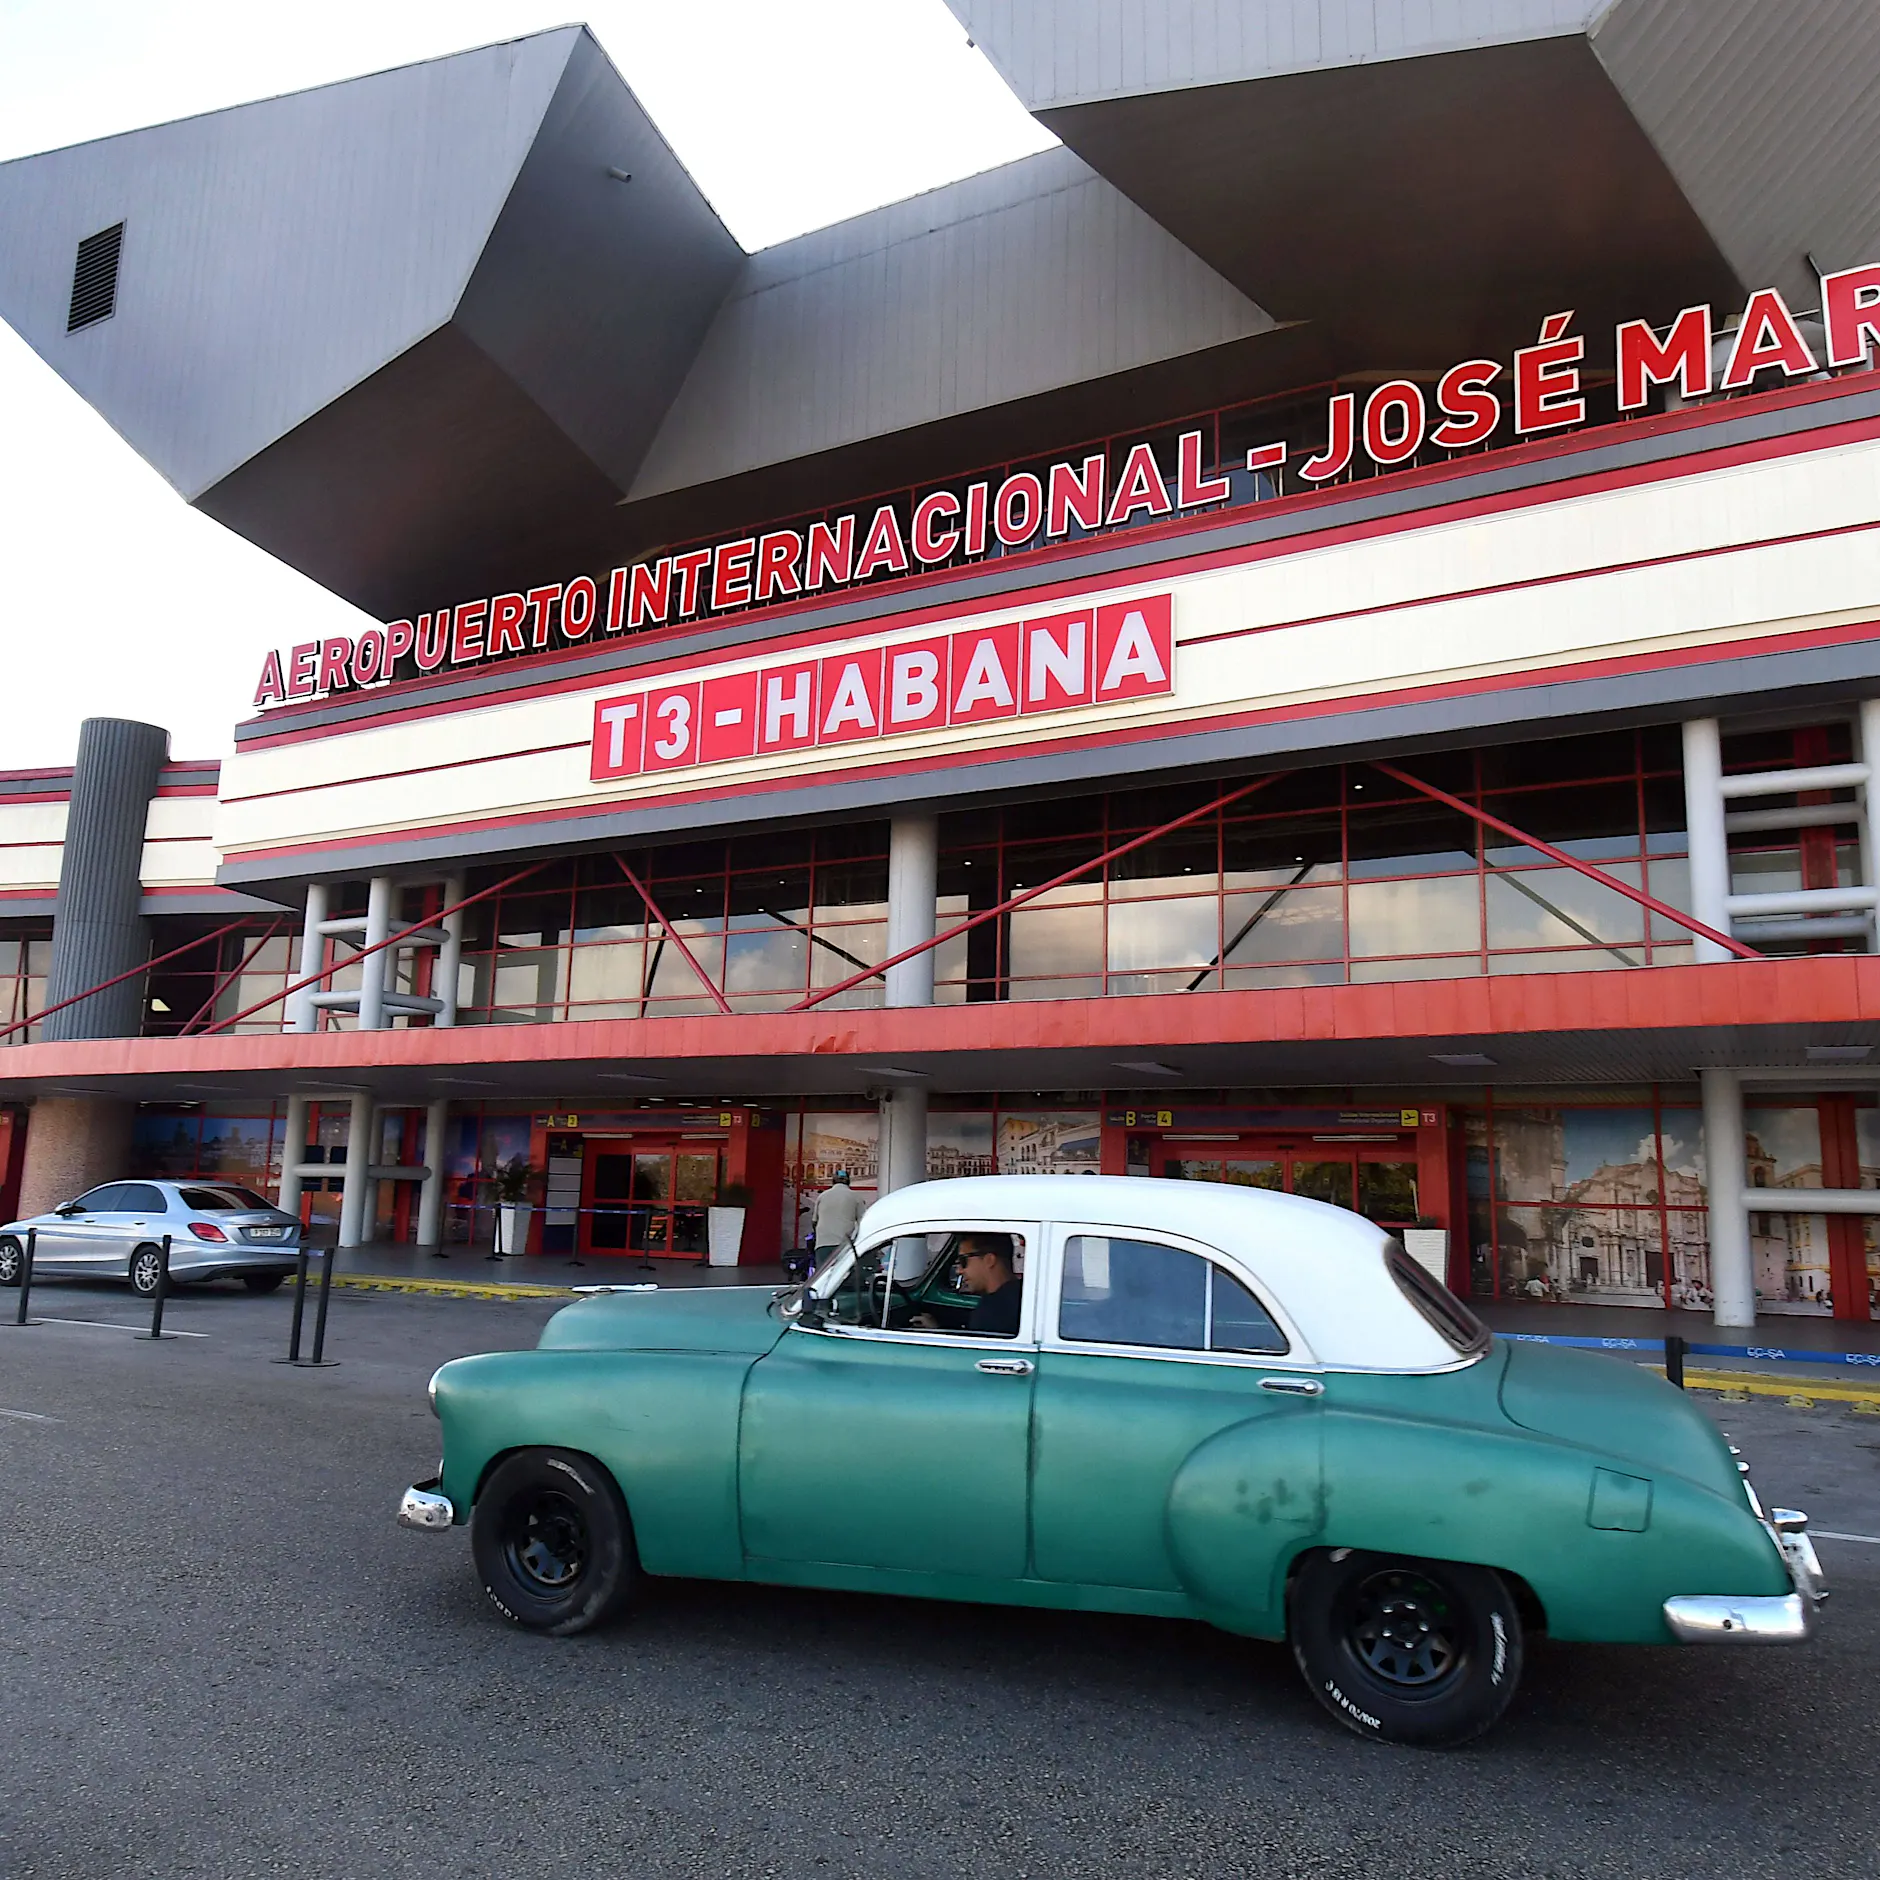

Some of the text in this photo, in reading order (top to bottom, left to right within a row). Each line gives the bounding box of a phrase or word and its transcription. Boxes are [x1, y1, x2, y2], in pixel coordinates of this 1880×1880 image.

[253, 576, 597, 706] AEROPUERTO
[606, 431, 1230, 630] INTERNACIONAL
[1298, 310, 1586, 482] JOSÉ
[547, 1115, 555, 1127] A
[1126, 1111, 1136, 1126] B
[1422, 1113, 1436, 1123] T3
